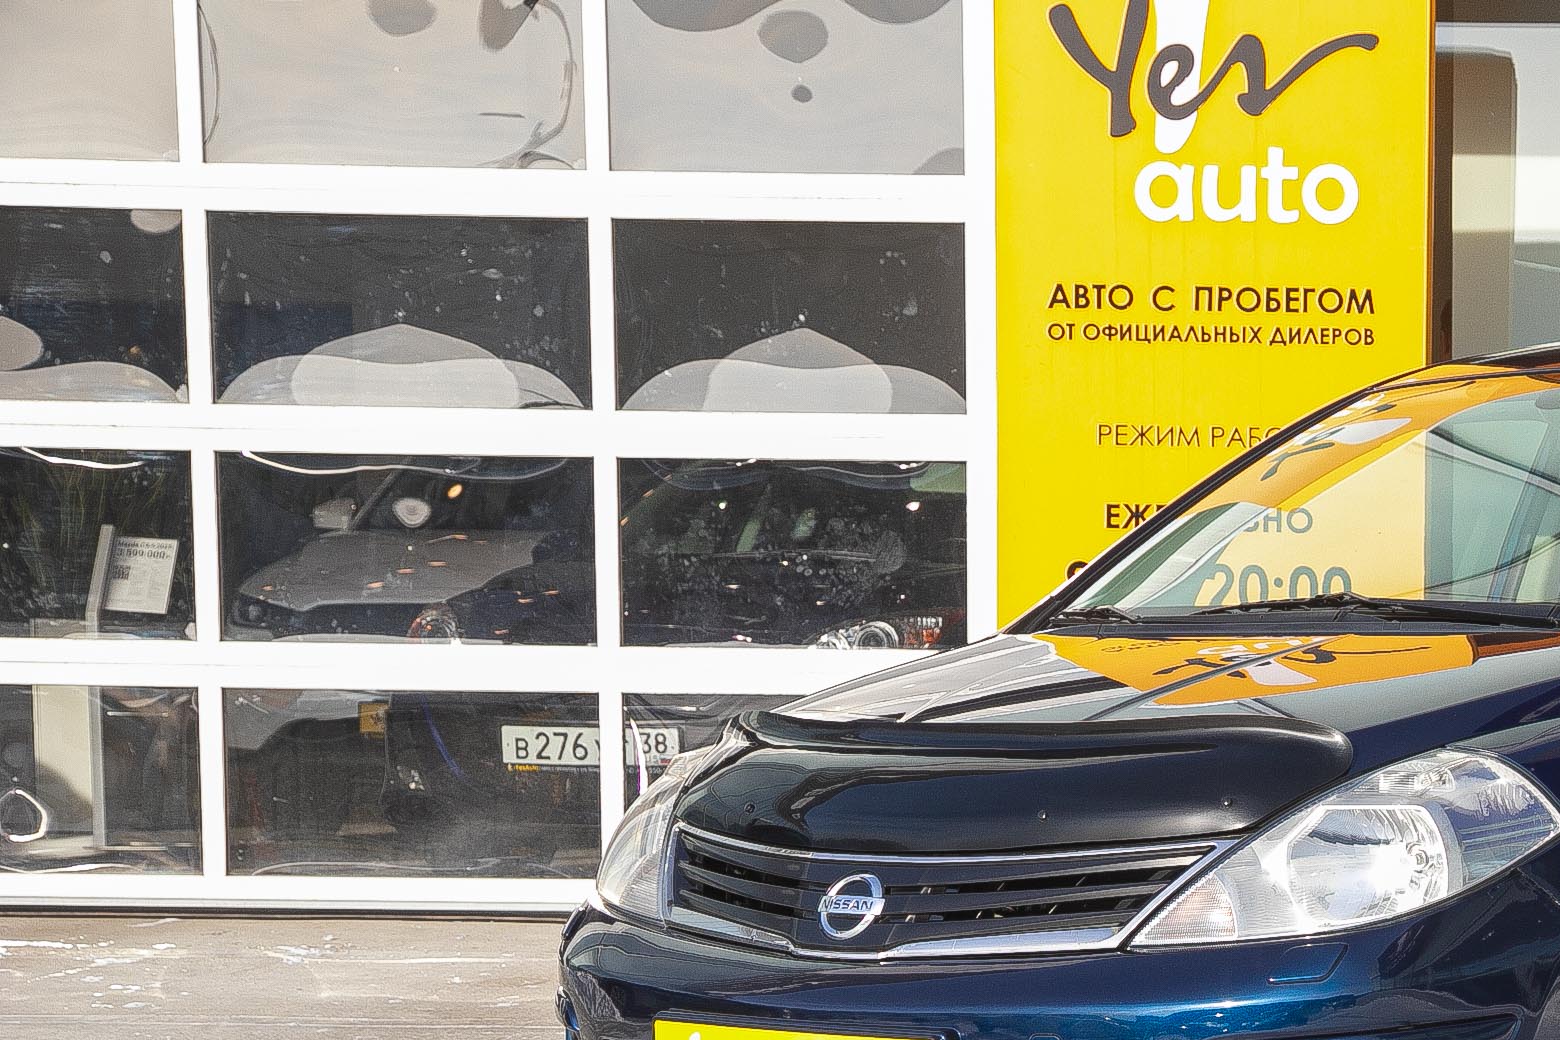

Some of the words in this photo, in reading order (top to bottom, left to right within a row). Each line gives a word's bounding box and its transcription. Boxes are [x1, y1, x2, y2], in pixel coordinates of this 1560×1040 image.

[1049, 0, 1379, 137] Yes
[1134, 146, 1358, 224] auto
[1048, 283, 1134, 311] АВТО
[1152, 285, 1175, 312] С
[1194, 286, 1375, 315] ПРОБЕГОМ
[1047, 323, 1076, 342] ОТ
[1082, 323, 1262, 344] ОФИЦИАЛЬНЫХ
[1269, 326, 1375, 347] ДИЛЕРОВ
[1098, 424, 1201, 447] РЕЖИМ
[1211, 426, 1281, 449] РАБ
[514, 732, 599, 761] В276
[822, 899, 873, 911] NISSAN
